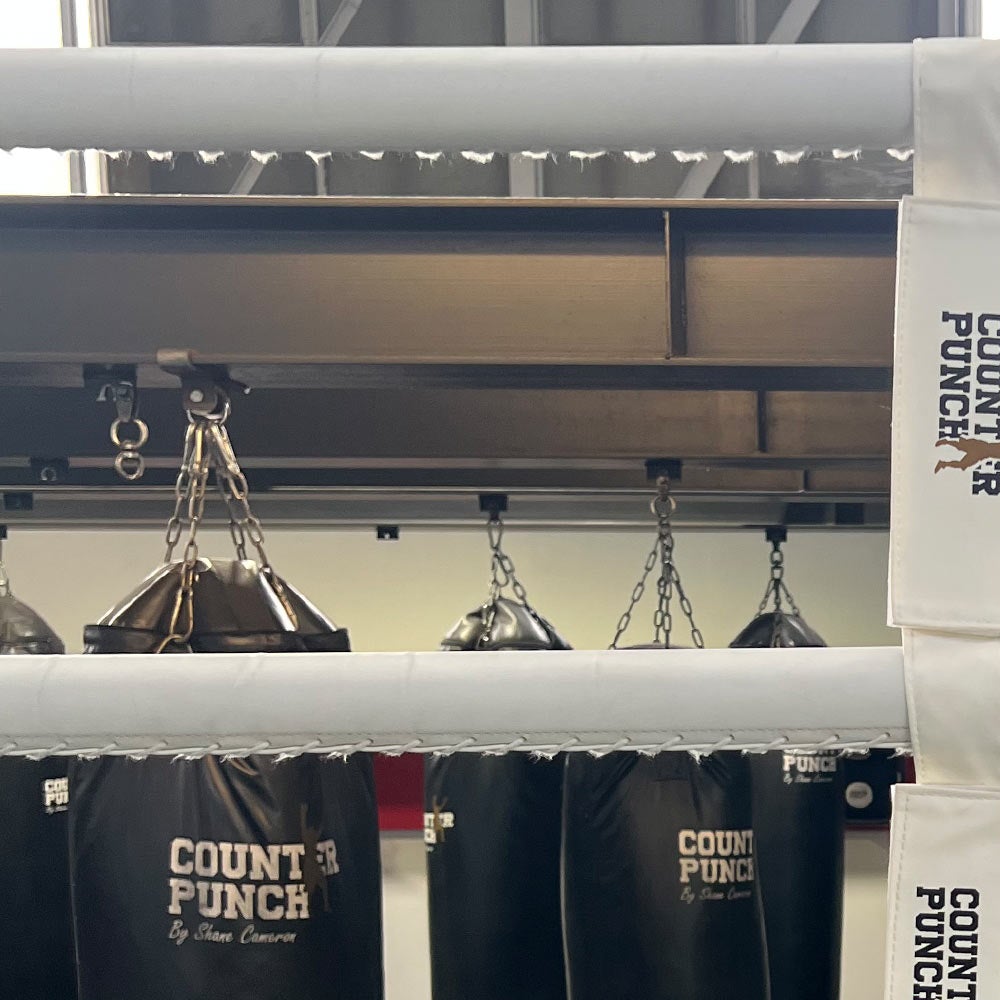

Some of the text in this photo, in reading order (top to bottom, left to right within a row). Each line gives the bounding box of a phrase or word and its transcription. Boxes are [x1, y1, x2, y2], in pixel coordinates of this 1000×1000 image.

[939, 311, 973, 439] PUNCH
[168, 878, 310, 920] PUNCH
[168, 919, 297, 945] By Shane Cameron
